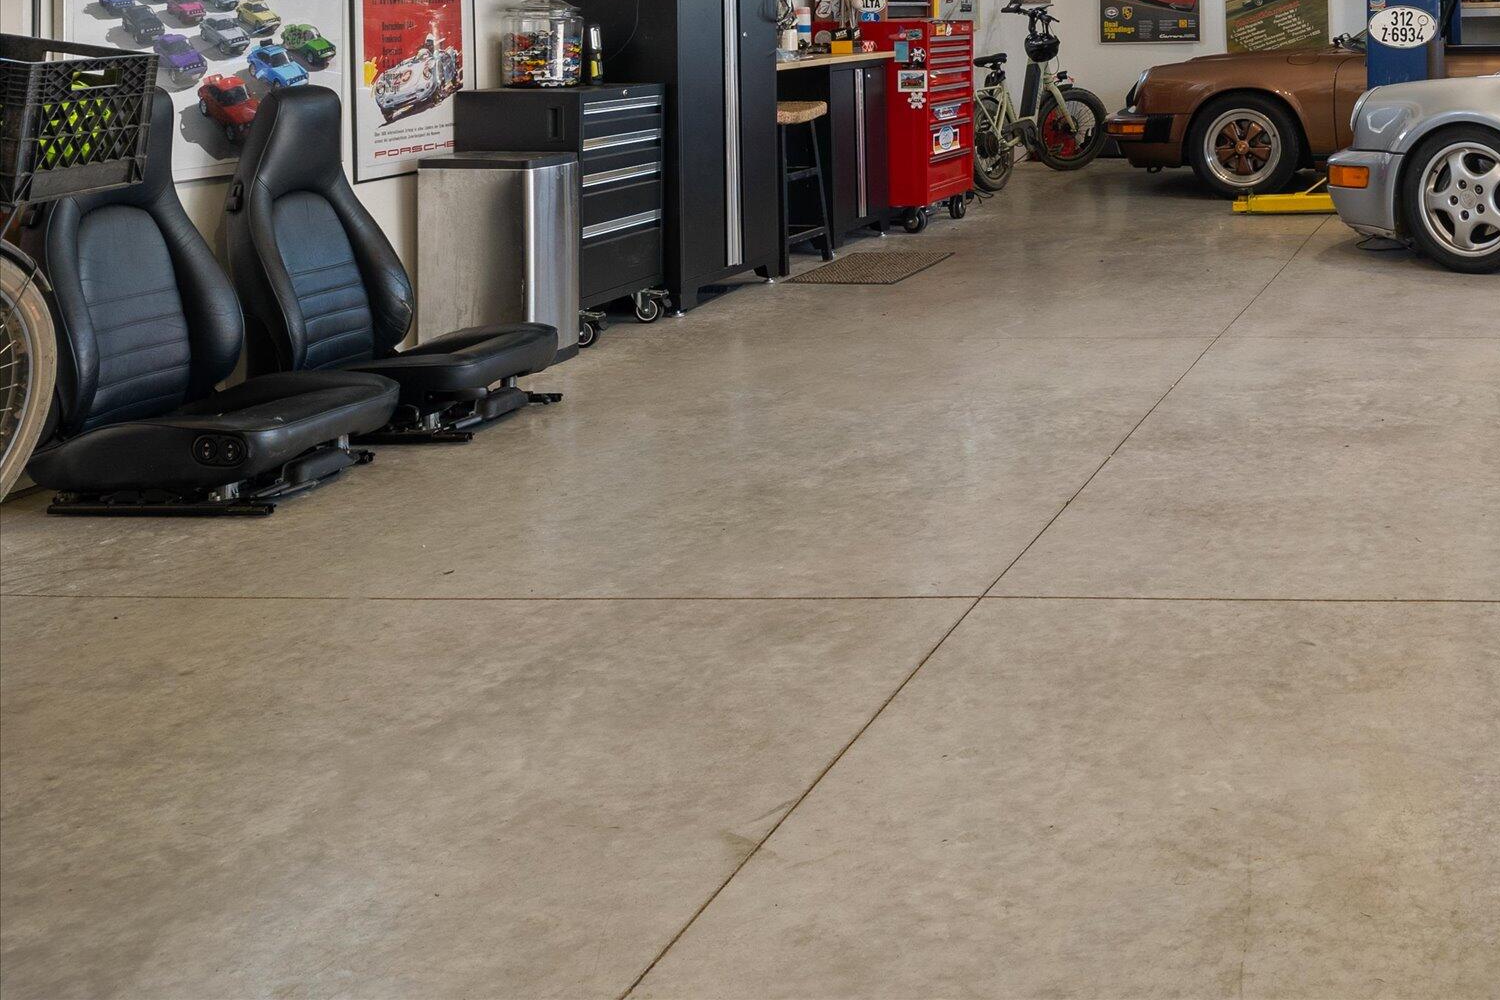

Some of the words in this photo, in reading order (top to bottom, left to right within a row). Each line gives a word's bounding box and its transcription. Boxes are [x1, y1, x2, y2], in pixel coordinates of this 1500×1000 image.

[1391, 11, 1413, 26] 312
[1382, 26, 1424, 42] Z-6934
[374, 140, 456, 159] PORSCHE
